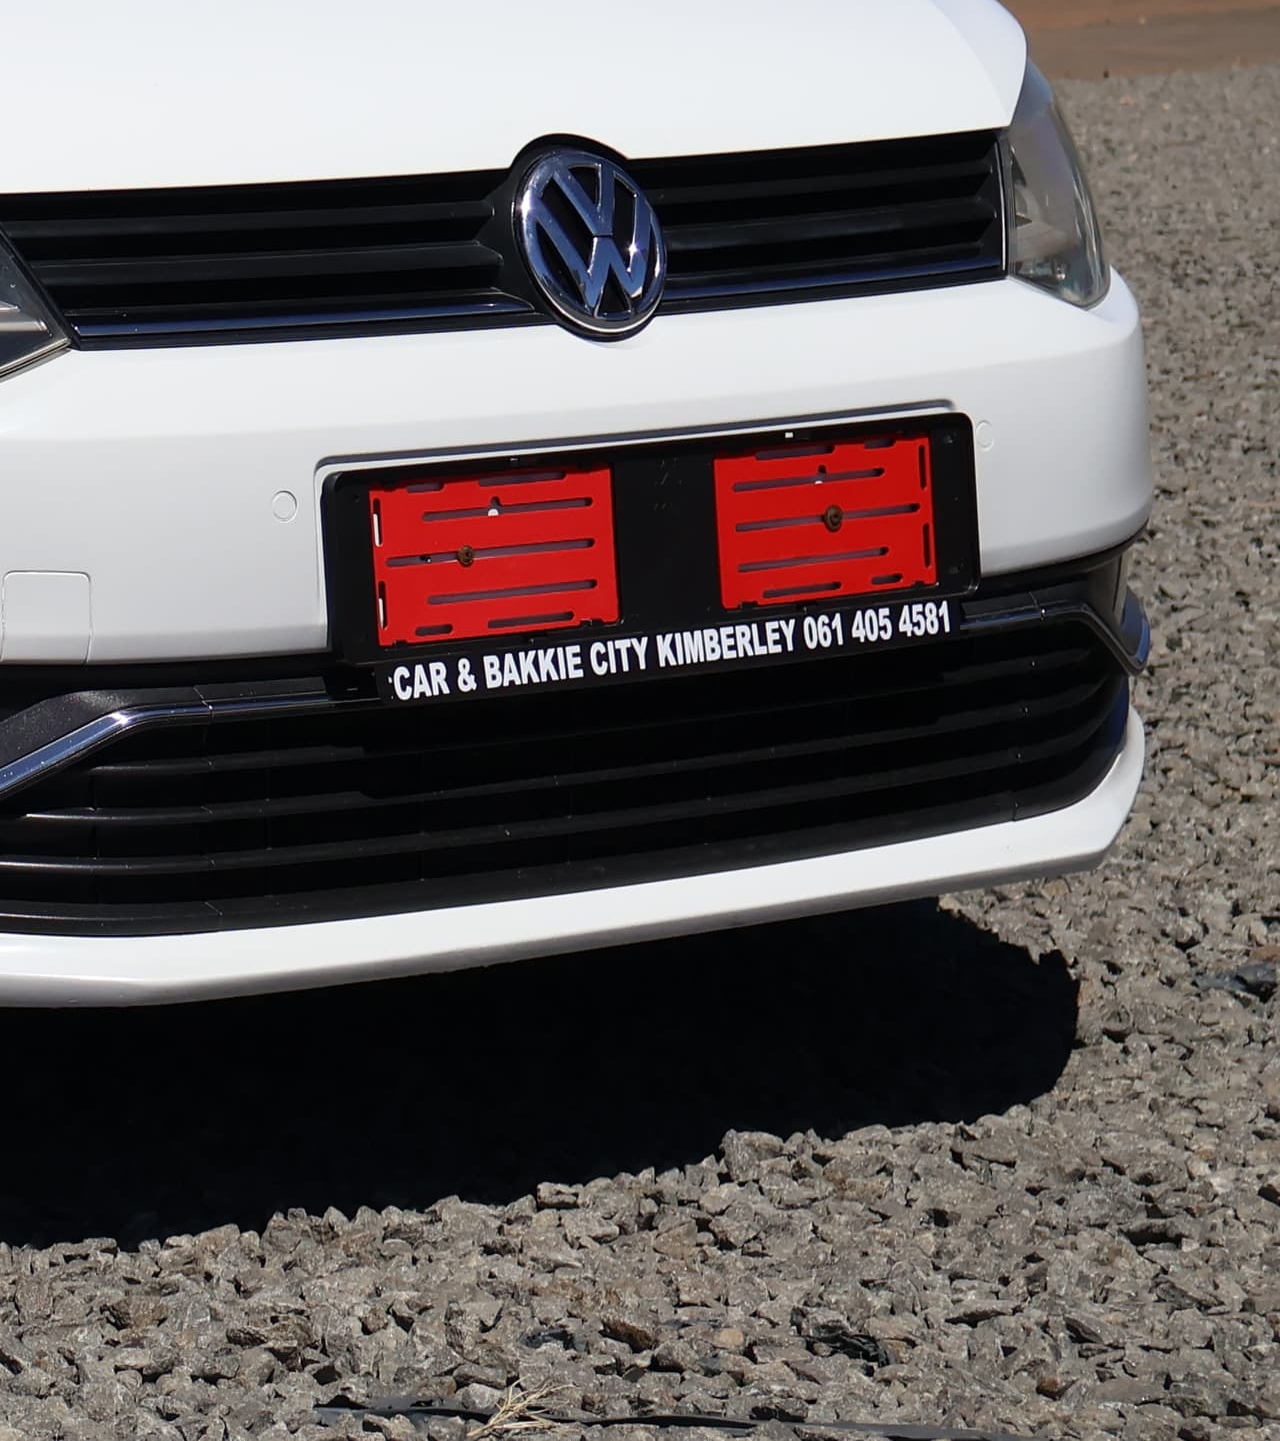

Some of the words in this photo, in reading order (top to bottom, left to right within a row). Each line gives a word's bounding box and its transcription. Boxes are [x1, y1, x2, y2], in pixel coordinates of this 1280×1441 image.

[393, 662, 450, 700] CAR
[457, 658, 477, 692] &
[483, 645, 584, 689] BAKKIE
[590, 637, 648, 676] CITY
[656, 619, 796, 667] KIMBERLEY
[803, 613, 844, 649] 061
[852, 608, 892, 643] 405
[899, 600, 950, 637] 4581
